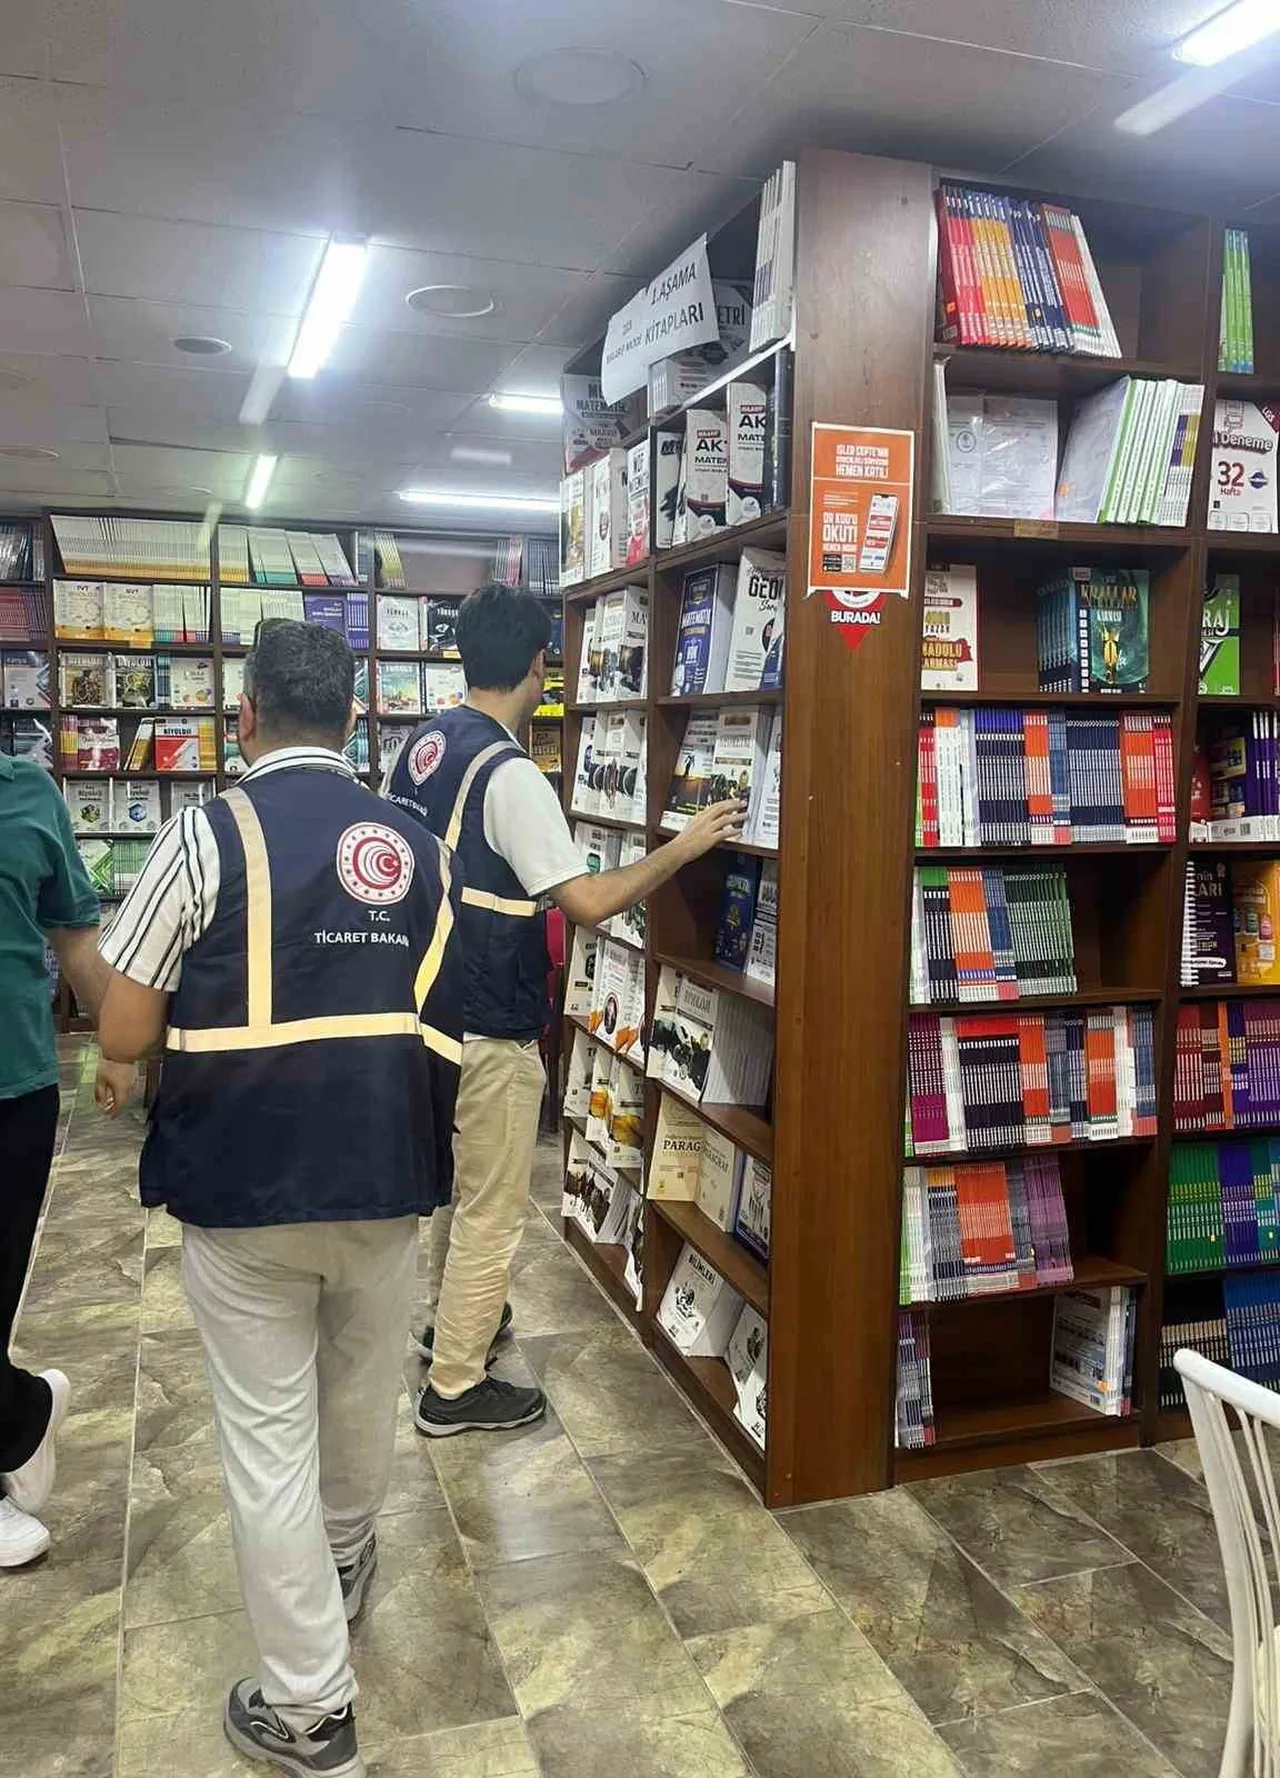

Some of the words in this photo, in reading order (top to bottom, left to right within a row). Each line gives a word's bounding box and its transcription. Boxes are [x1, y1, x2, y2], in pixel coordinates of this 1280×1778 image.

[645, 301, 704, 345] KİTAPLARI
[1221, 431, 1273, 452] Deneme
[1218, 461, 1245, 487] 32
[831, 610, 881, 624] BURADA!
[368, 910, 391, 922] T.C.
[314, 929, 369, 944] TİCARET
